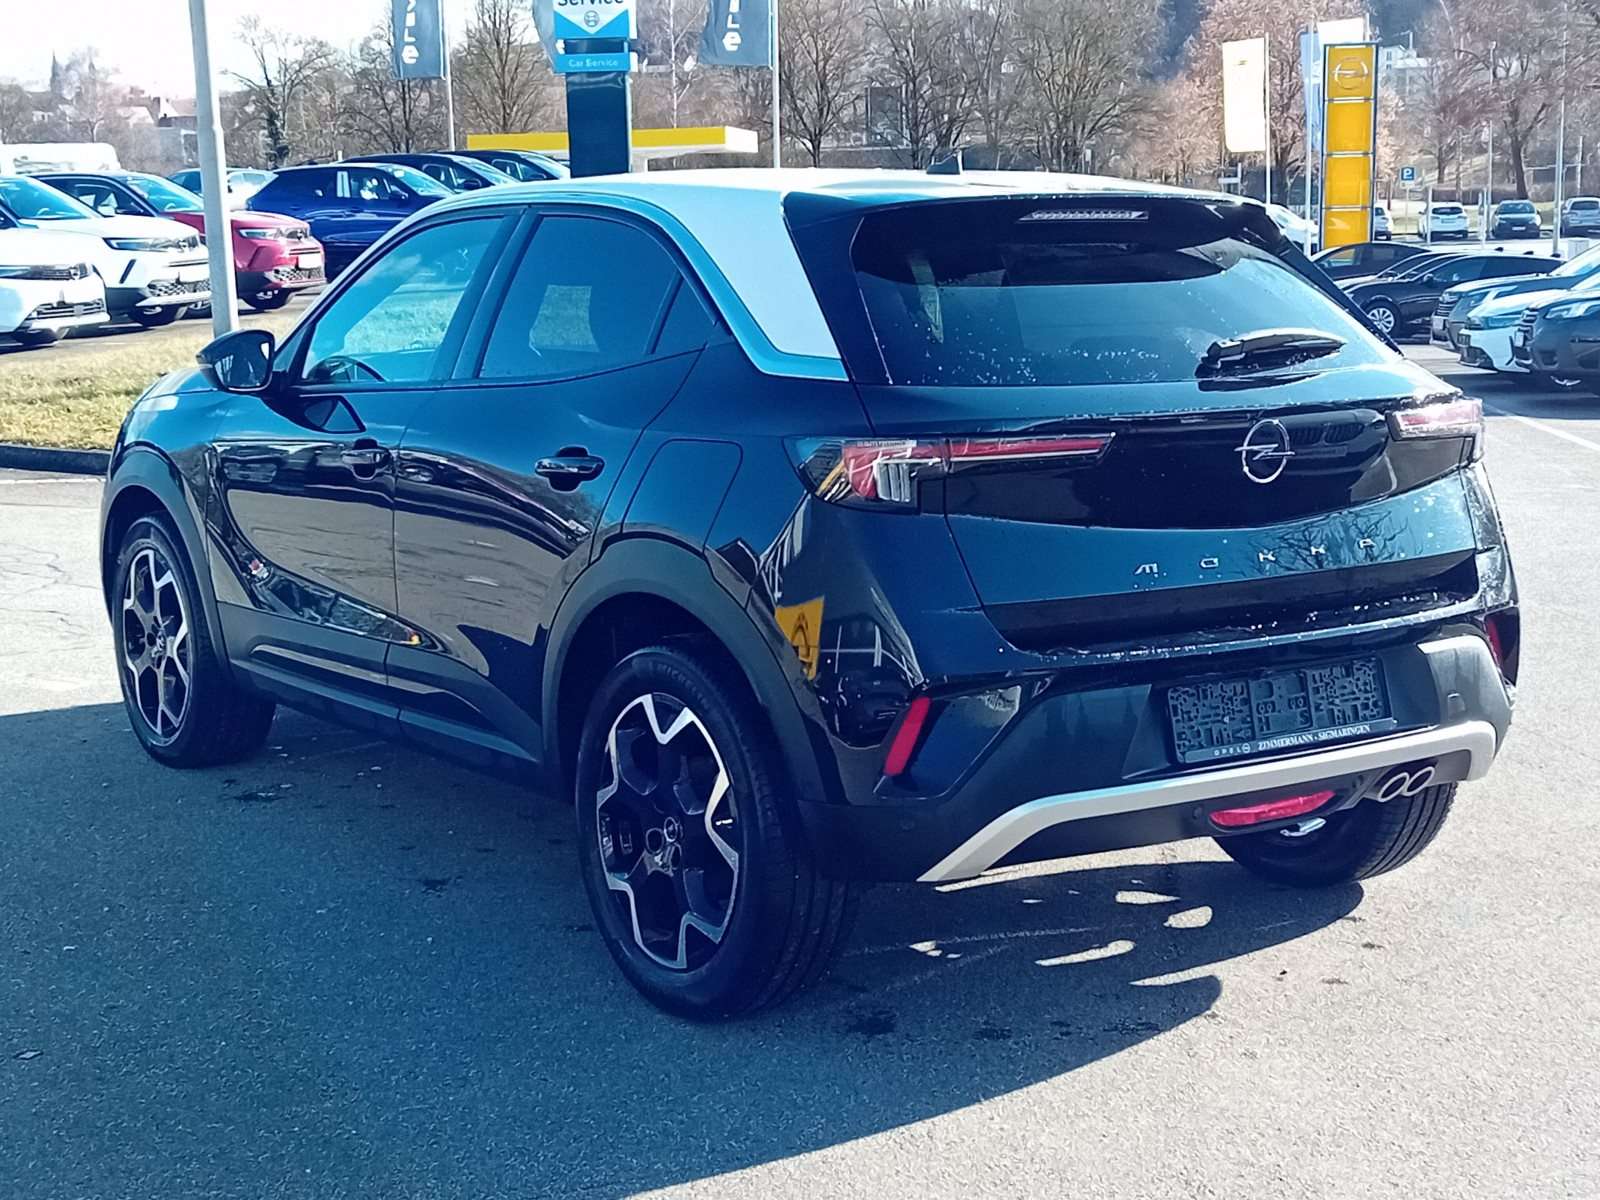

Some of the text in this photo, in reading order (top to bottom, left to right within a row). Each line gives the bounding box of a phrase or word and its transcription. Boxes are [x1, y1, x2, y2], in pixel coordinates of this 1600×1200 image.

[1402, 167, 1413, 180] P
[1257, 733, 1314, 751] ZIMMERMANN
[1318, 724, 1371, 741] SIGMARINGEN
